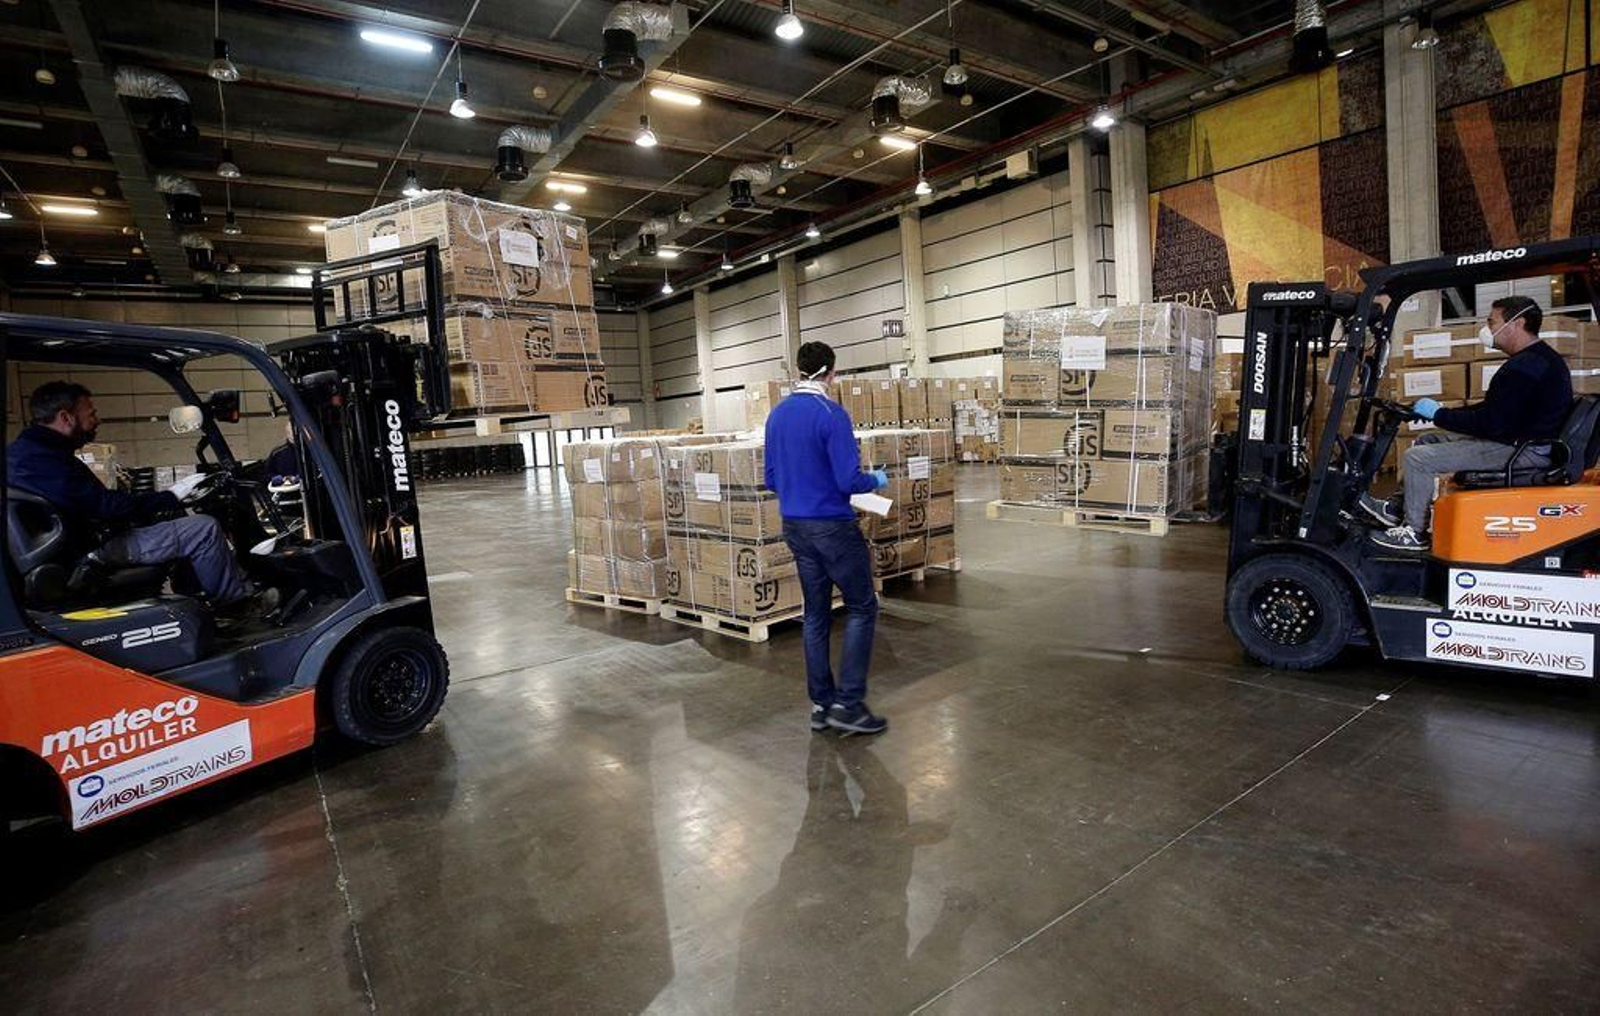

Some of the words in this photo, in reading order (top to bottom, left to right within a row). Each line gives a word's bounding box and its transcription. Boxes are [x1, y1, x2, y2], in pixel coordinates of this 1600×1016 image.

[1456, 248, 1527, 266] mateco
[1262, 290, 1316, 301] mateco
[1254, 332, 1268, 394] DOOSAN
[385, 400, 409, 491] mateco
[1484, 516, 1537, 532] 25
[1538, 504, 1588, 517] GX
[754, 581, 773, 602] SF
[82, 634, 118, 646] GENEO
[121, 621, 182, 649] 25
[1432, 642, 1586, 671] MOLDTRANS
[41, 695, 199, 757] mateco
[60, 717, 198, 775] ALQUILER
[80, 745, 246, 821] MOLDTRANS
